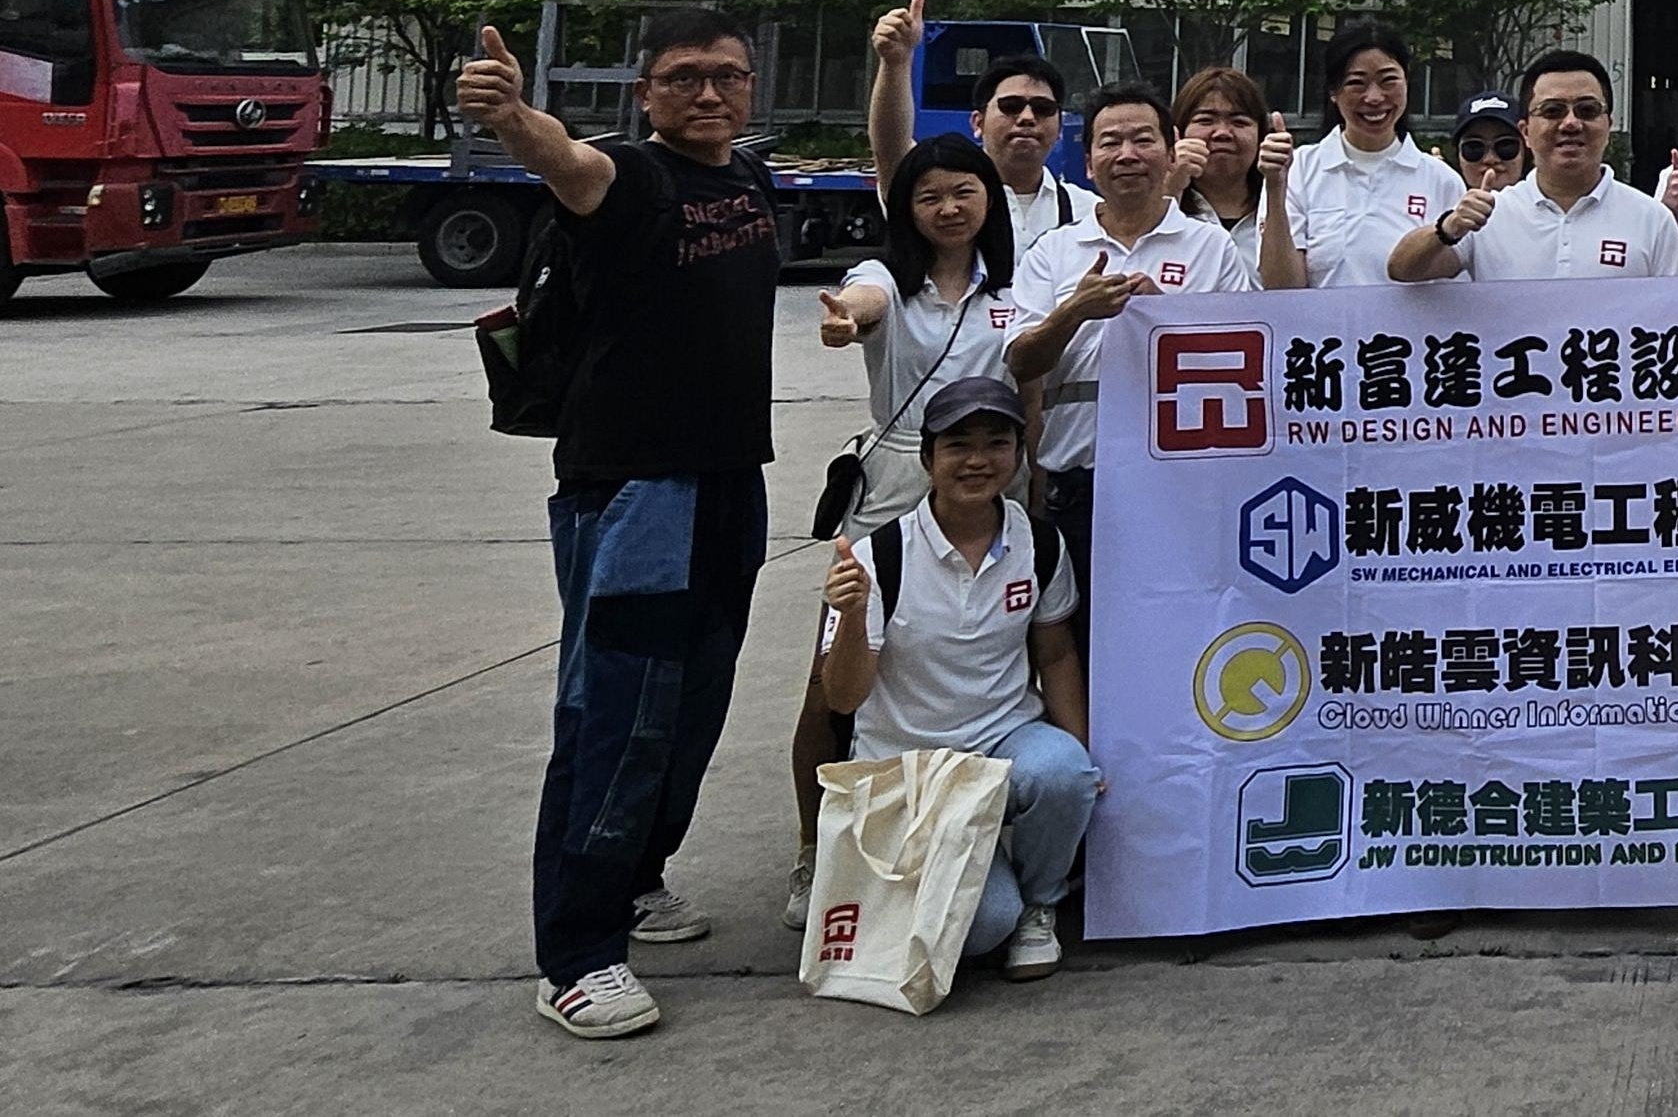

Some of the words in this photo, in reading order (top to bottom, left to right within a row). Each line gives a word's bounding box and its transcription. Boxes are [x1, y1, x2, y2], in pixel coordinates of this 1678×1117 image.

[1288, 422, 1330, 444] RW
[1342, 417, 1453, 443] DESIGN
[1467, 414, 1527, 439] AND
[1351, 568, 1378, 581] SW
[1382, 562, 1501, 581] MECHANICAL
[1506, 562, 1542, 577] AND
[1547, 559, 1658, 577] ELECTRICAL
[1318, 700, 1408, 730] Cloud
[1415, 702, 1520, 730] Winner
[1358, 845, 1397, 869] JW
[1405, 842, 1602, 867] CONSTRUCTION
[1610, 843, 1667, 865] AND
